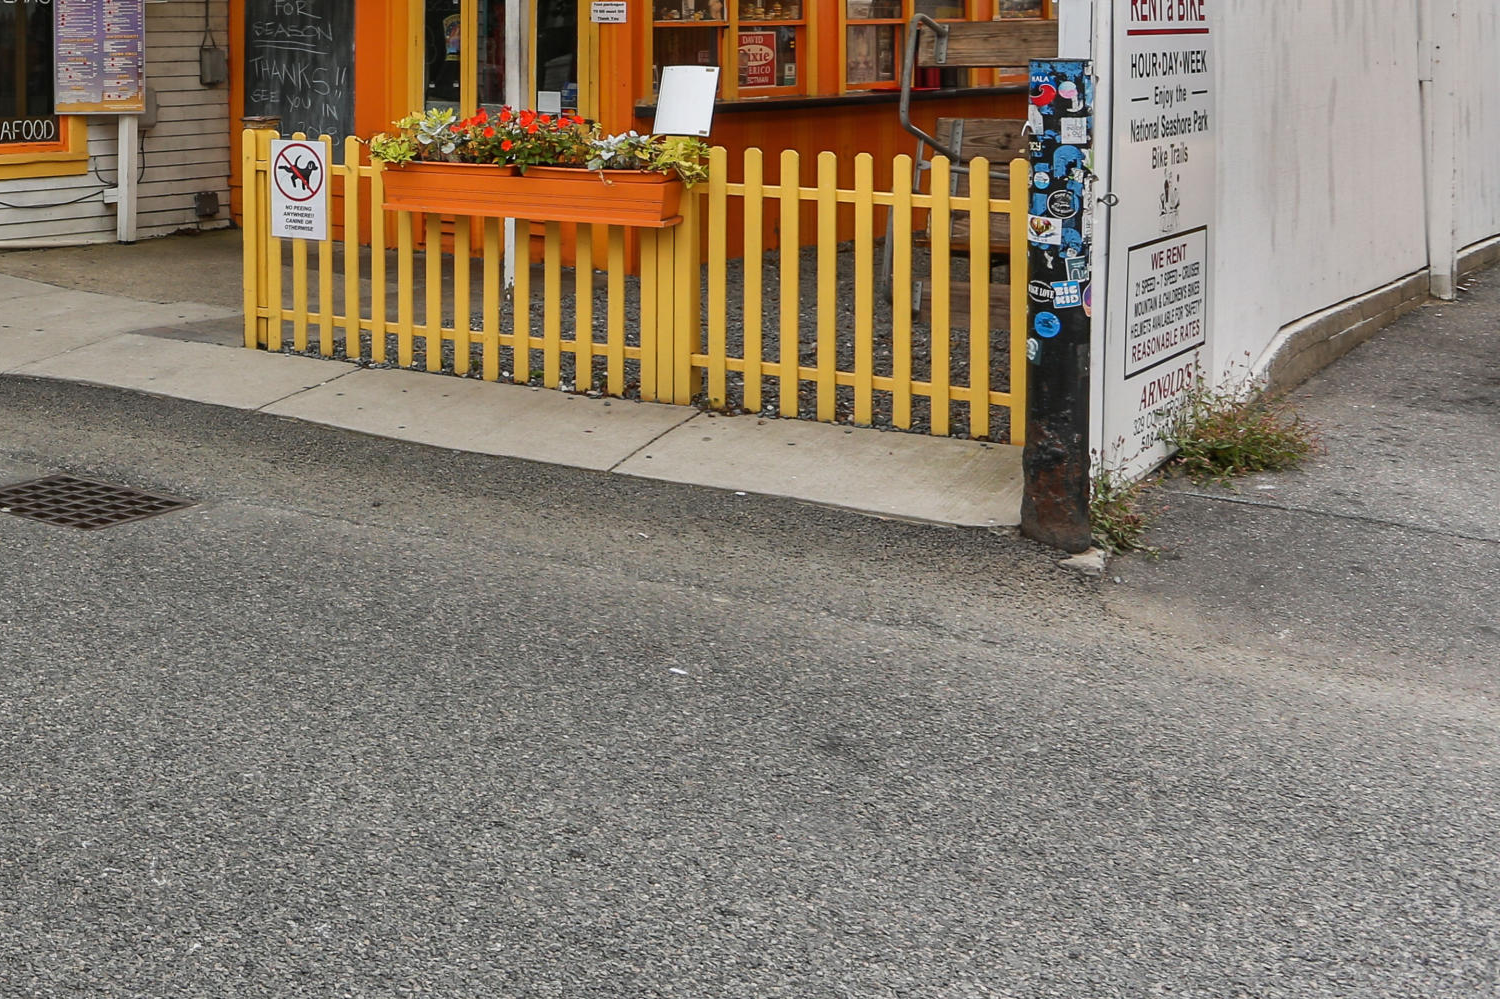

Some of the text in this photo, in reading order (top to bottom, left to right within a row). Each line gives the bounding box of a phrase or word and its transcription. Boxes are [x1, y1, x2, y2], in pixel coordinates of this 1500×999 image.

[274, 0, 322, 19] FOR
[252, 21, 333, 42] SEASON
[742, 35, 764, 44] DAVID
[249, 55, 347, 98] THANKS!!
[747, 65, 771, 75] ERICO
[250, 88, 339, 121] SEE YOU IN
[1154, 83, 1187, 109] Enjoy the
[1130, 108, 1208, 144] National Seashore Park
[1151, 141, 1189, 170] Bike Trails
[1150, 243, 1188, 271] WE RENT
[1135, 279, 1142, 298] 21
[1141, 276, 1156, 295] SPEED
[1164, 269, 1178, 287] SPEED
[1133, 295, 1158, 318] MOUNTAIN
[1187, 280, 1200, 299] BIKES
[1130, 317, 1152, 341] HELMETS
[1151, 307, 1175, 333] AVAILABLE
[1175, 305, 1184, 322] FOR
[1131, 318, 1201, 364] REASONABLE RATES
[1138, 362, 1193, 412] ARNOLD'S
